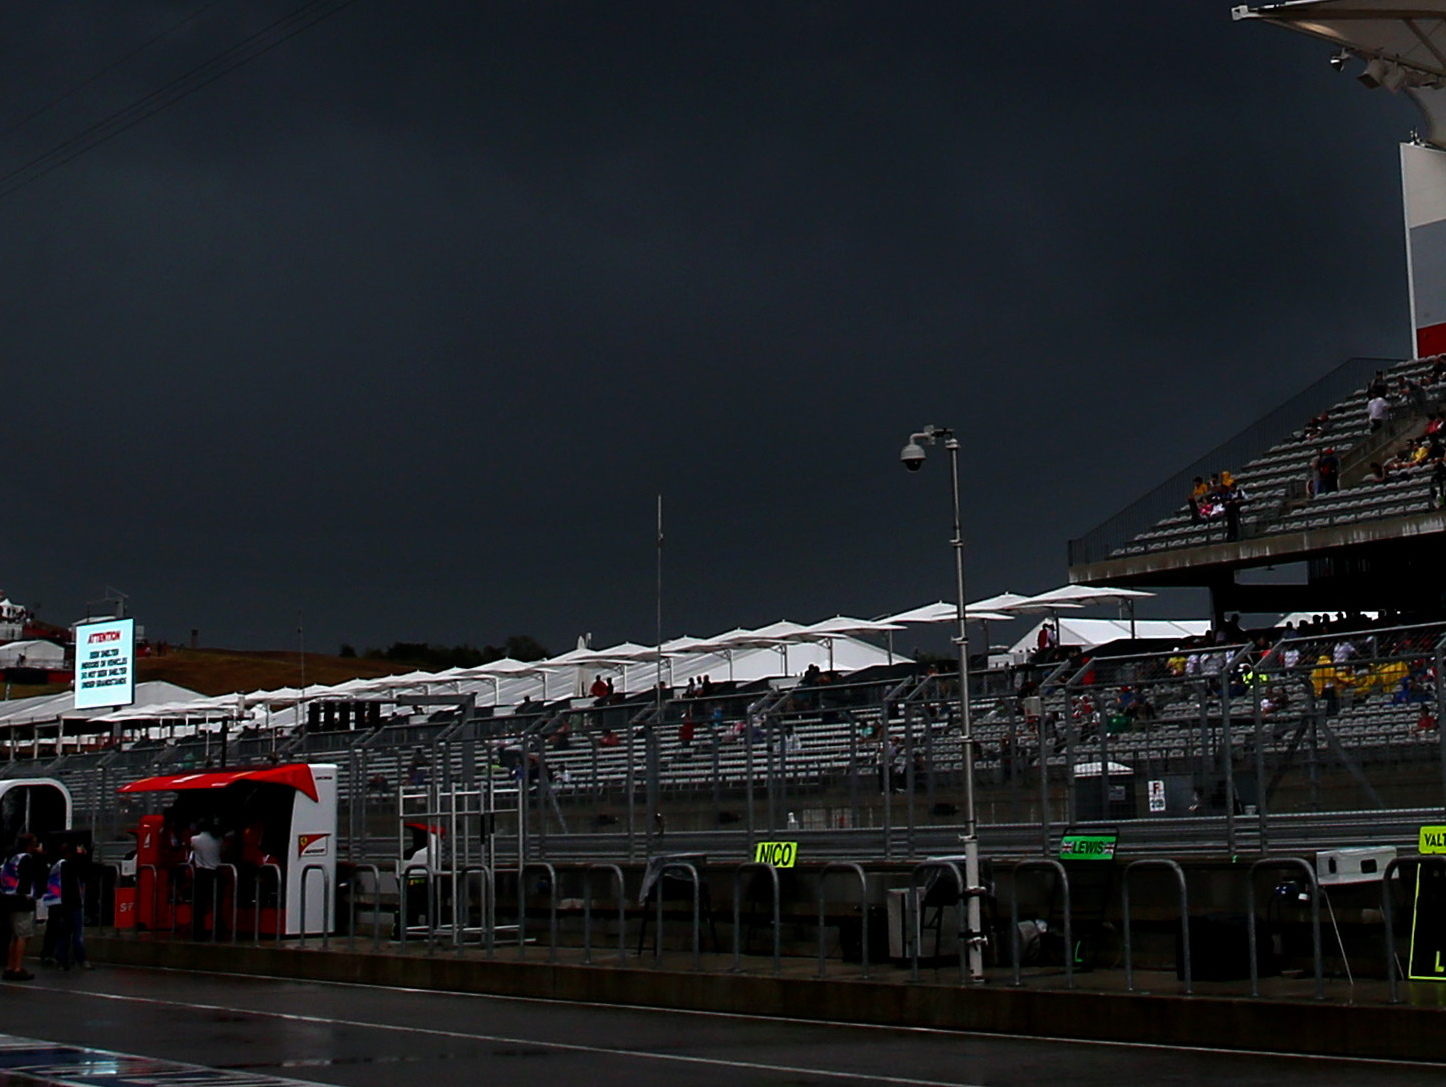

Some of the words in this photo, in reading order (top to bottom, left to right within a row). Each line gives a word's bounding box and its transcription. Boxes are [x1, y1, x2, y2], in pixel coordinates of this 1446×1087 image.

[759, 843, 792, 866] NICO
[1072, 840, 1105, 855] LEWIS
[1434, 950, 1445, 973] L
